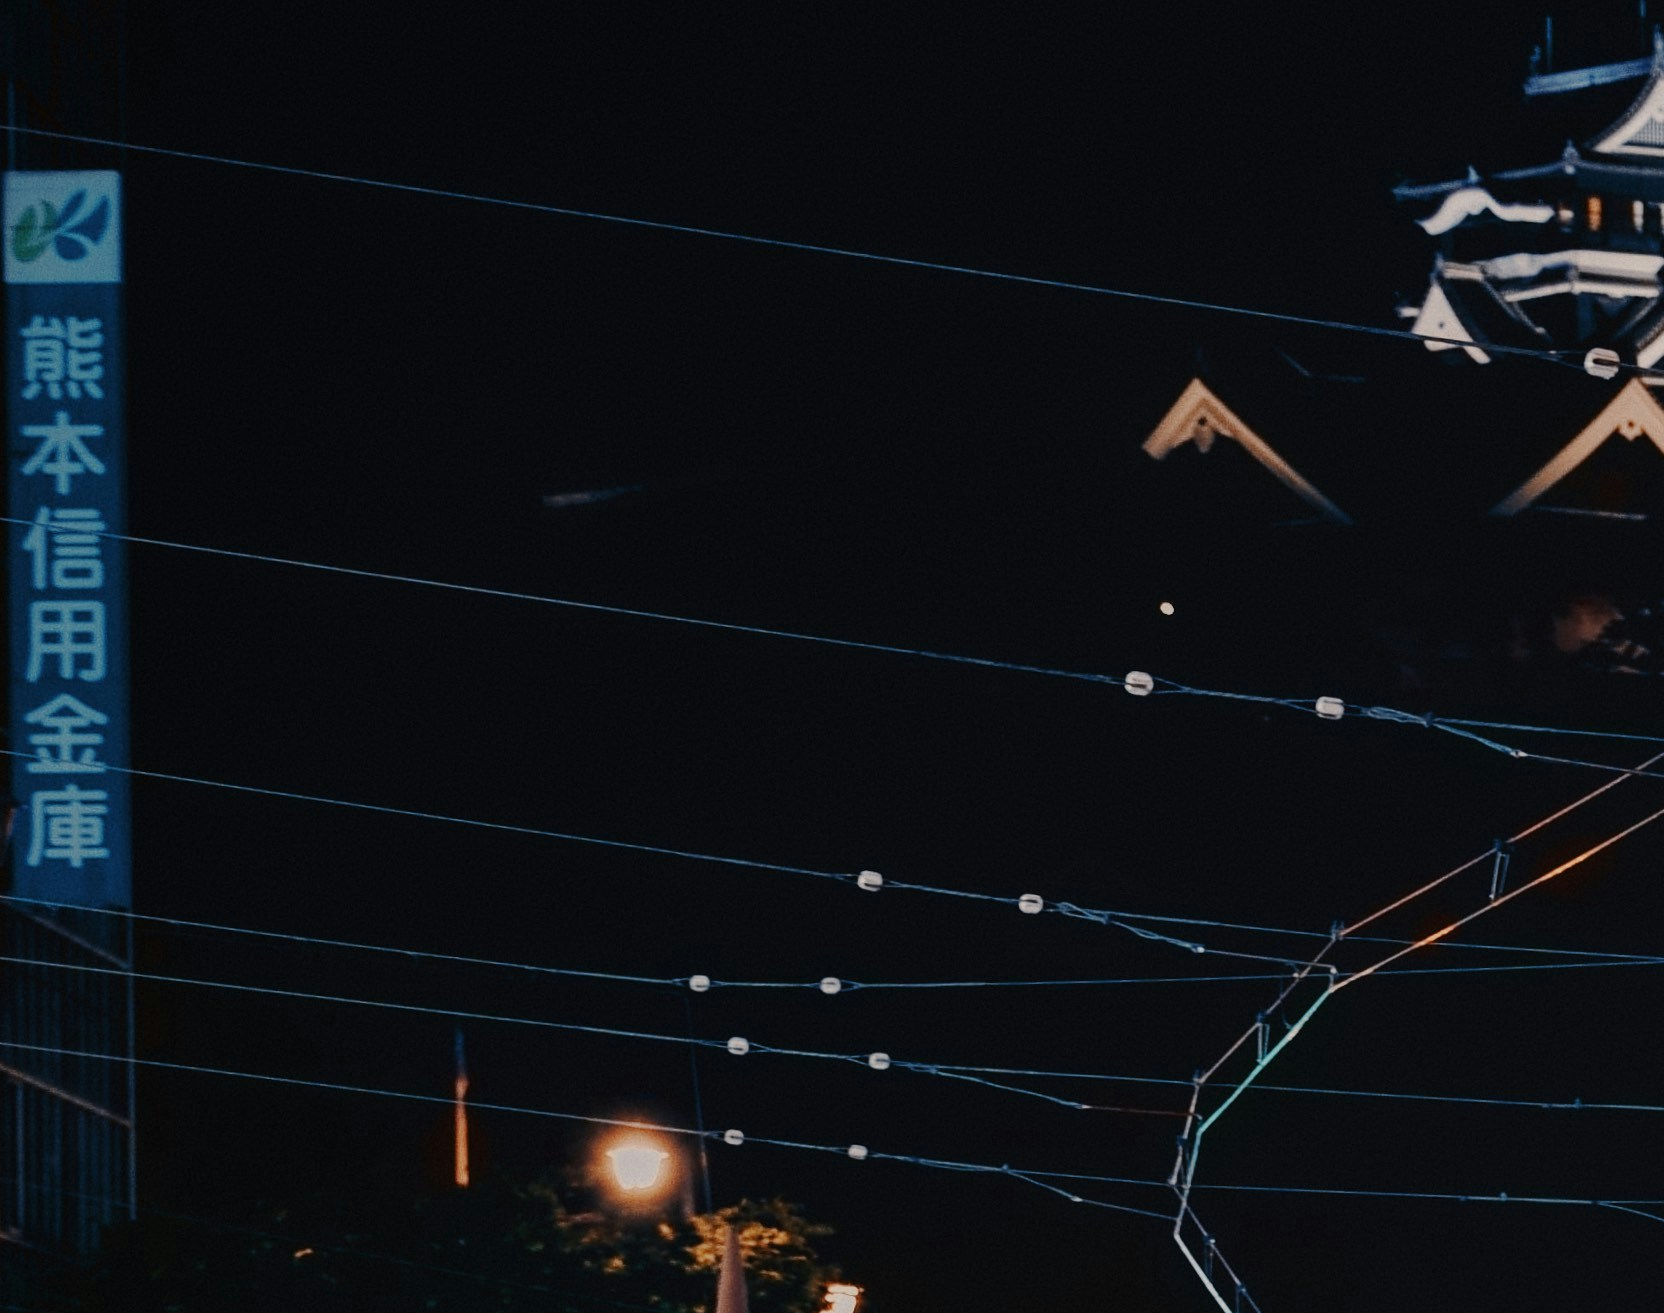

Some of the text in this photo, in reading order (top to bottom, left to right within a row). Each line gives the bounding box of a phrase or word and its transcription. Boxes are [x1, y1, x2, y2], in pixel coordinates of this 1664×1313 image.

[21, 315, 109, 868] 熊本信用金庫
